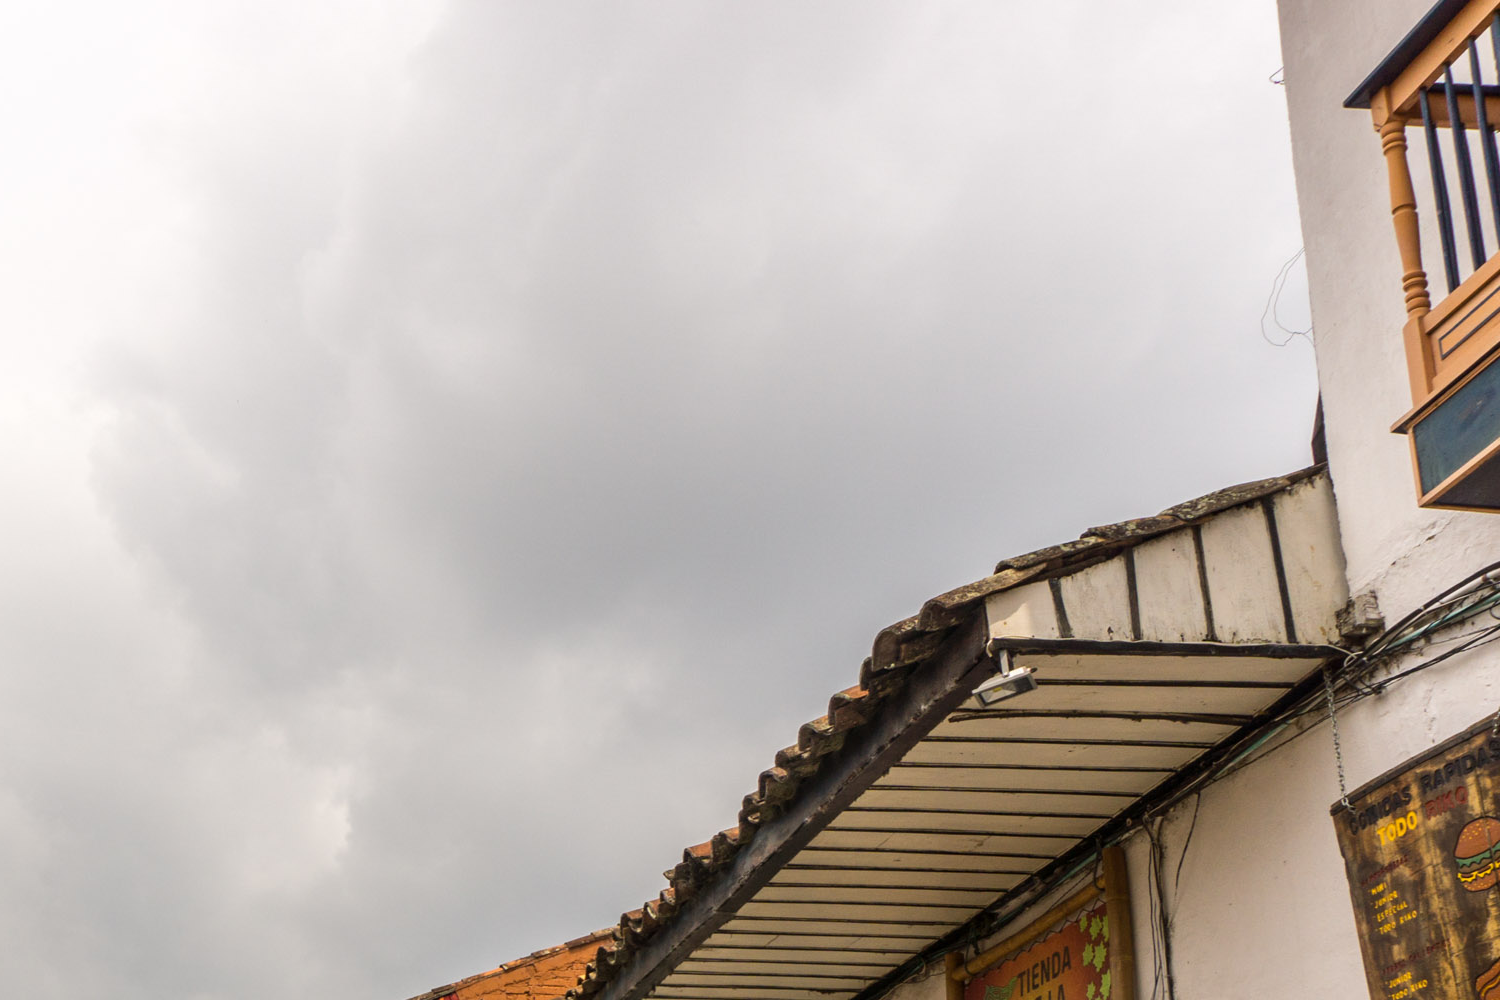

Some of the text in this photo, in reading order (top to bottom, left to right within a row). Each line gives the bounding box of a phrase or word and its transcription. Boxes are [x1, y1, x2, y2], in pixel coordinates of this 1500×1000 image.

[1348, 785, 1413, 836] COMIDAS
[1376, 785, 1468, 846] TODO RIKO
[1373, 890, 1398, 909] JUNIOR
[1375, 901, 1408, 921] ESPECIAL
[1378, 910, 1418, 935] TODO RIKO
[1017, 946, 1072, 997] TIENDA
[1388, 971, 1413, 988] JUNIOR
[1410, 979, 1428, 993] RIKO
